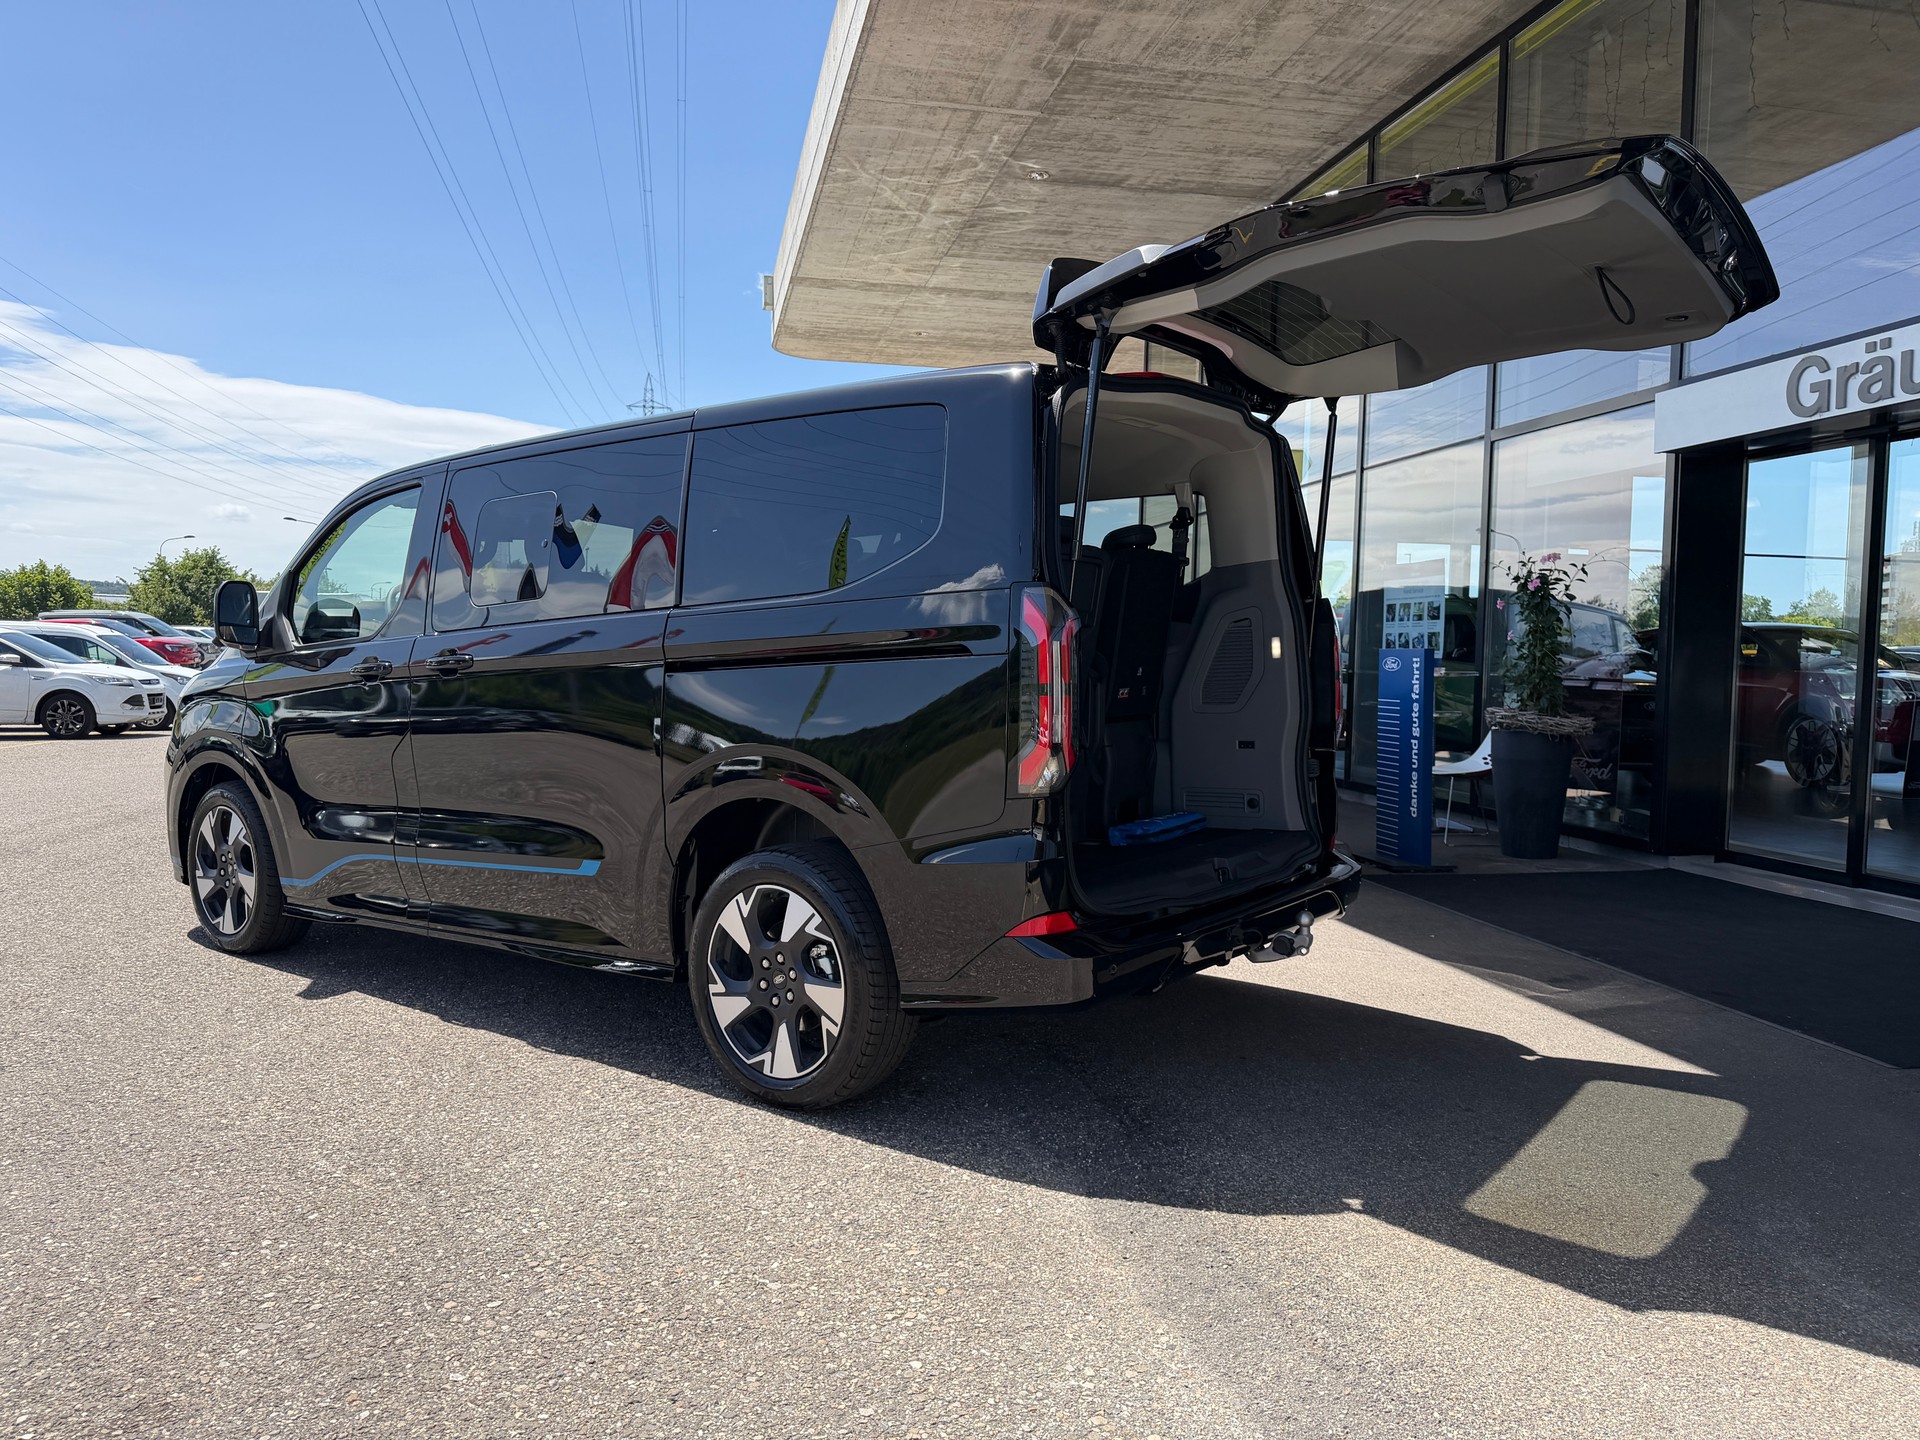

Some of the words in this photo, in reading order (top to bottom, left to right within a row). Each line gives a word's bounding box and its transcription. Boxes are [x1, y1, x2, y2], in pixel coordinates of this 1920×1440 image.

[1384, 657, 1400, 670] Ford
[1411, 657, 1420, 700] fahrt!
[1411, 703, 1420, 738] gute
[1410, 739, 1419, 769] und
[1410, 771, 1419, 818] danke
